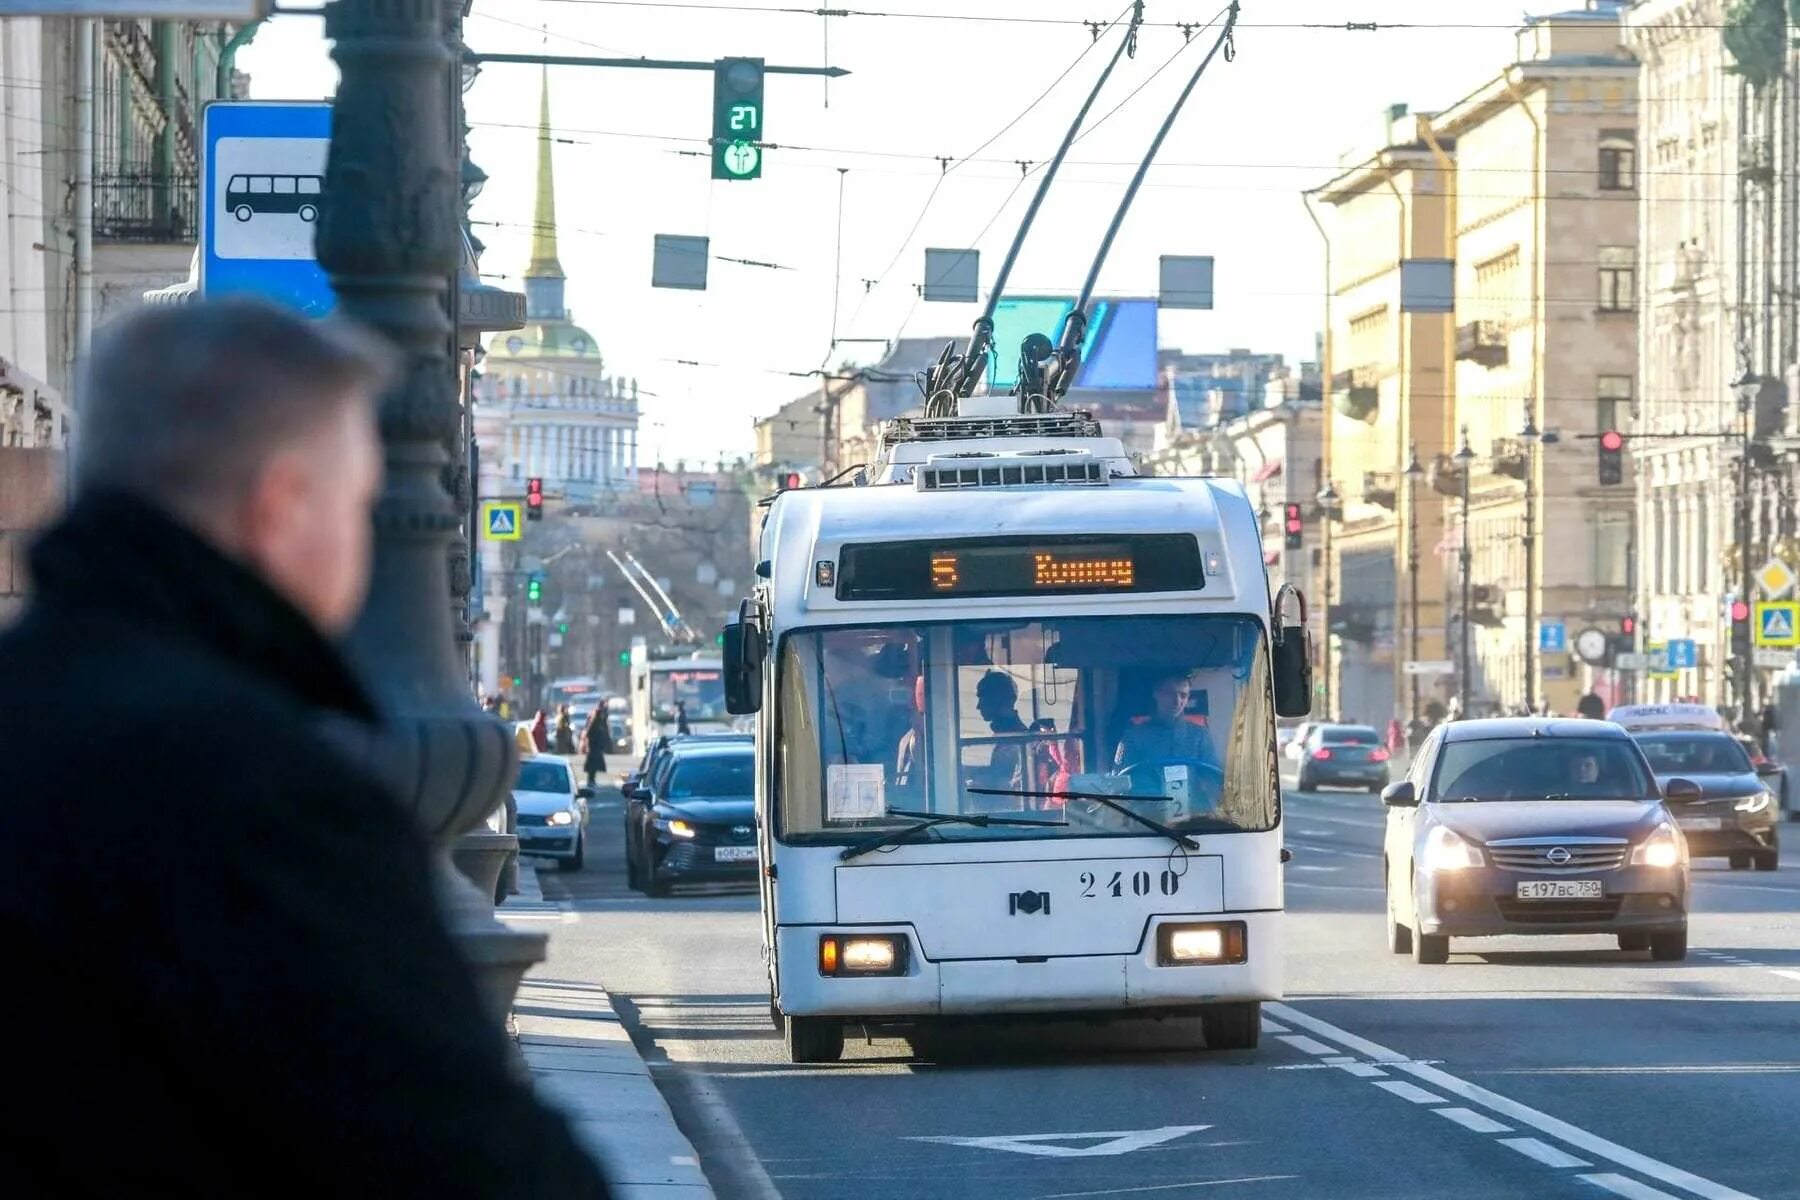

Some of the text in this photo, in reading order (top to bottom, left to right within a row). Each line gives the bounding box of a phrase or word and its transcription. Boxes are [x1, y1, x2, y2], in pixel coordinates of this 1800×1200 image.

[731, 106, 757, 129] 27
[932, 557, 958, 587] 5
[1080, 870, 1179, 898] 2400
